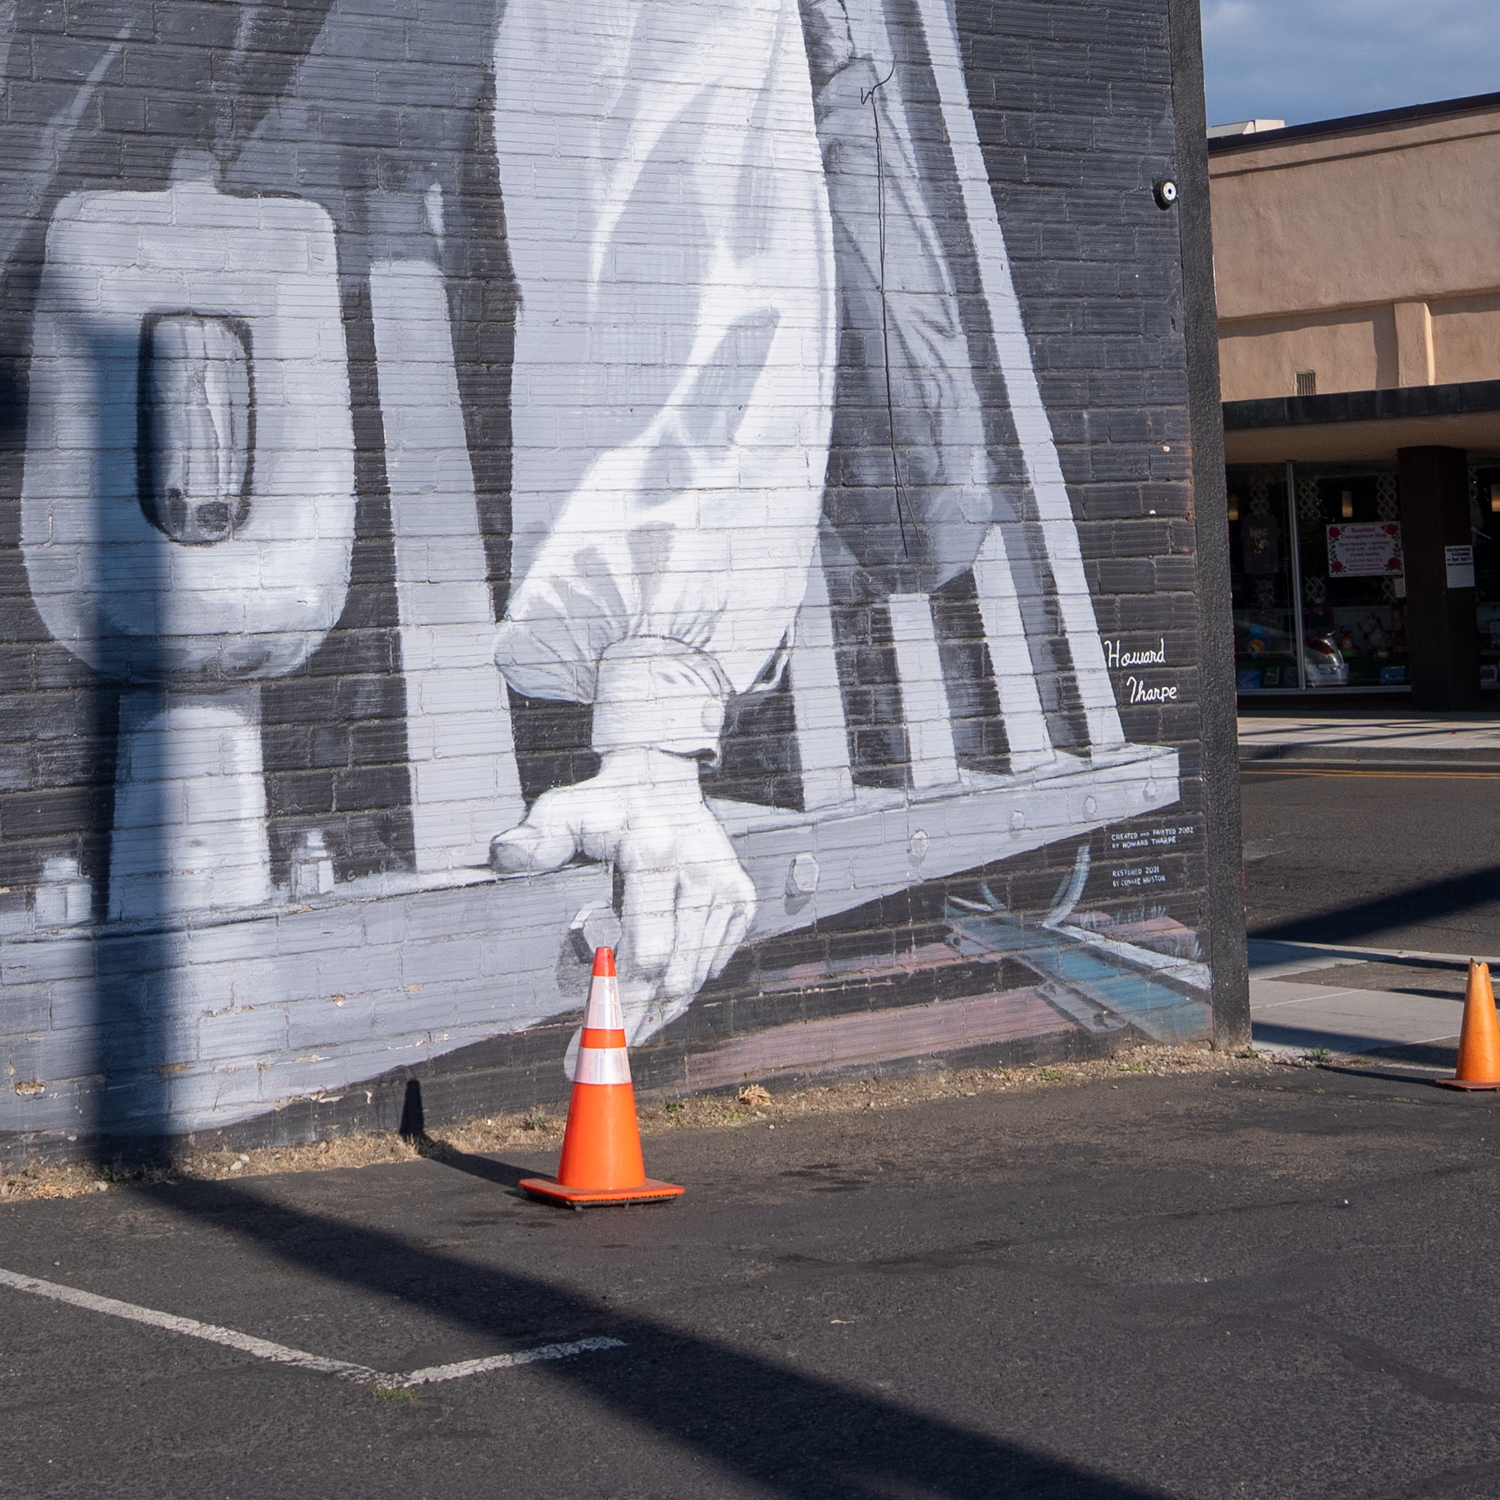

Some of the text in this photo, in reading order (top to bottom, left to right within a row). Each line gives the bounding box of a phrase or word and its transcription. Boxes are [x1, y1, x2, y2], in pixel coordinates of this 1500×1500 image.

[1104, 638, 1167, 668] Howard
[1126, 676, 1177, 703] Tharpe
[1111, 832, 1139, 841] CREATED
[1152, 828, 1177, 836] PAINTED
[1178, 826, 1195, 835] 2002
[1122, 839, 1149, 849] HOWARD
[1151, 836, 1177, 845] THARPE
[1112, 866, 1160, 877] RESTORED 2021
[1142, 875, 1166, 885] HUSTON
